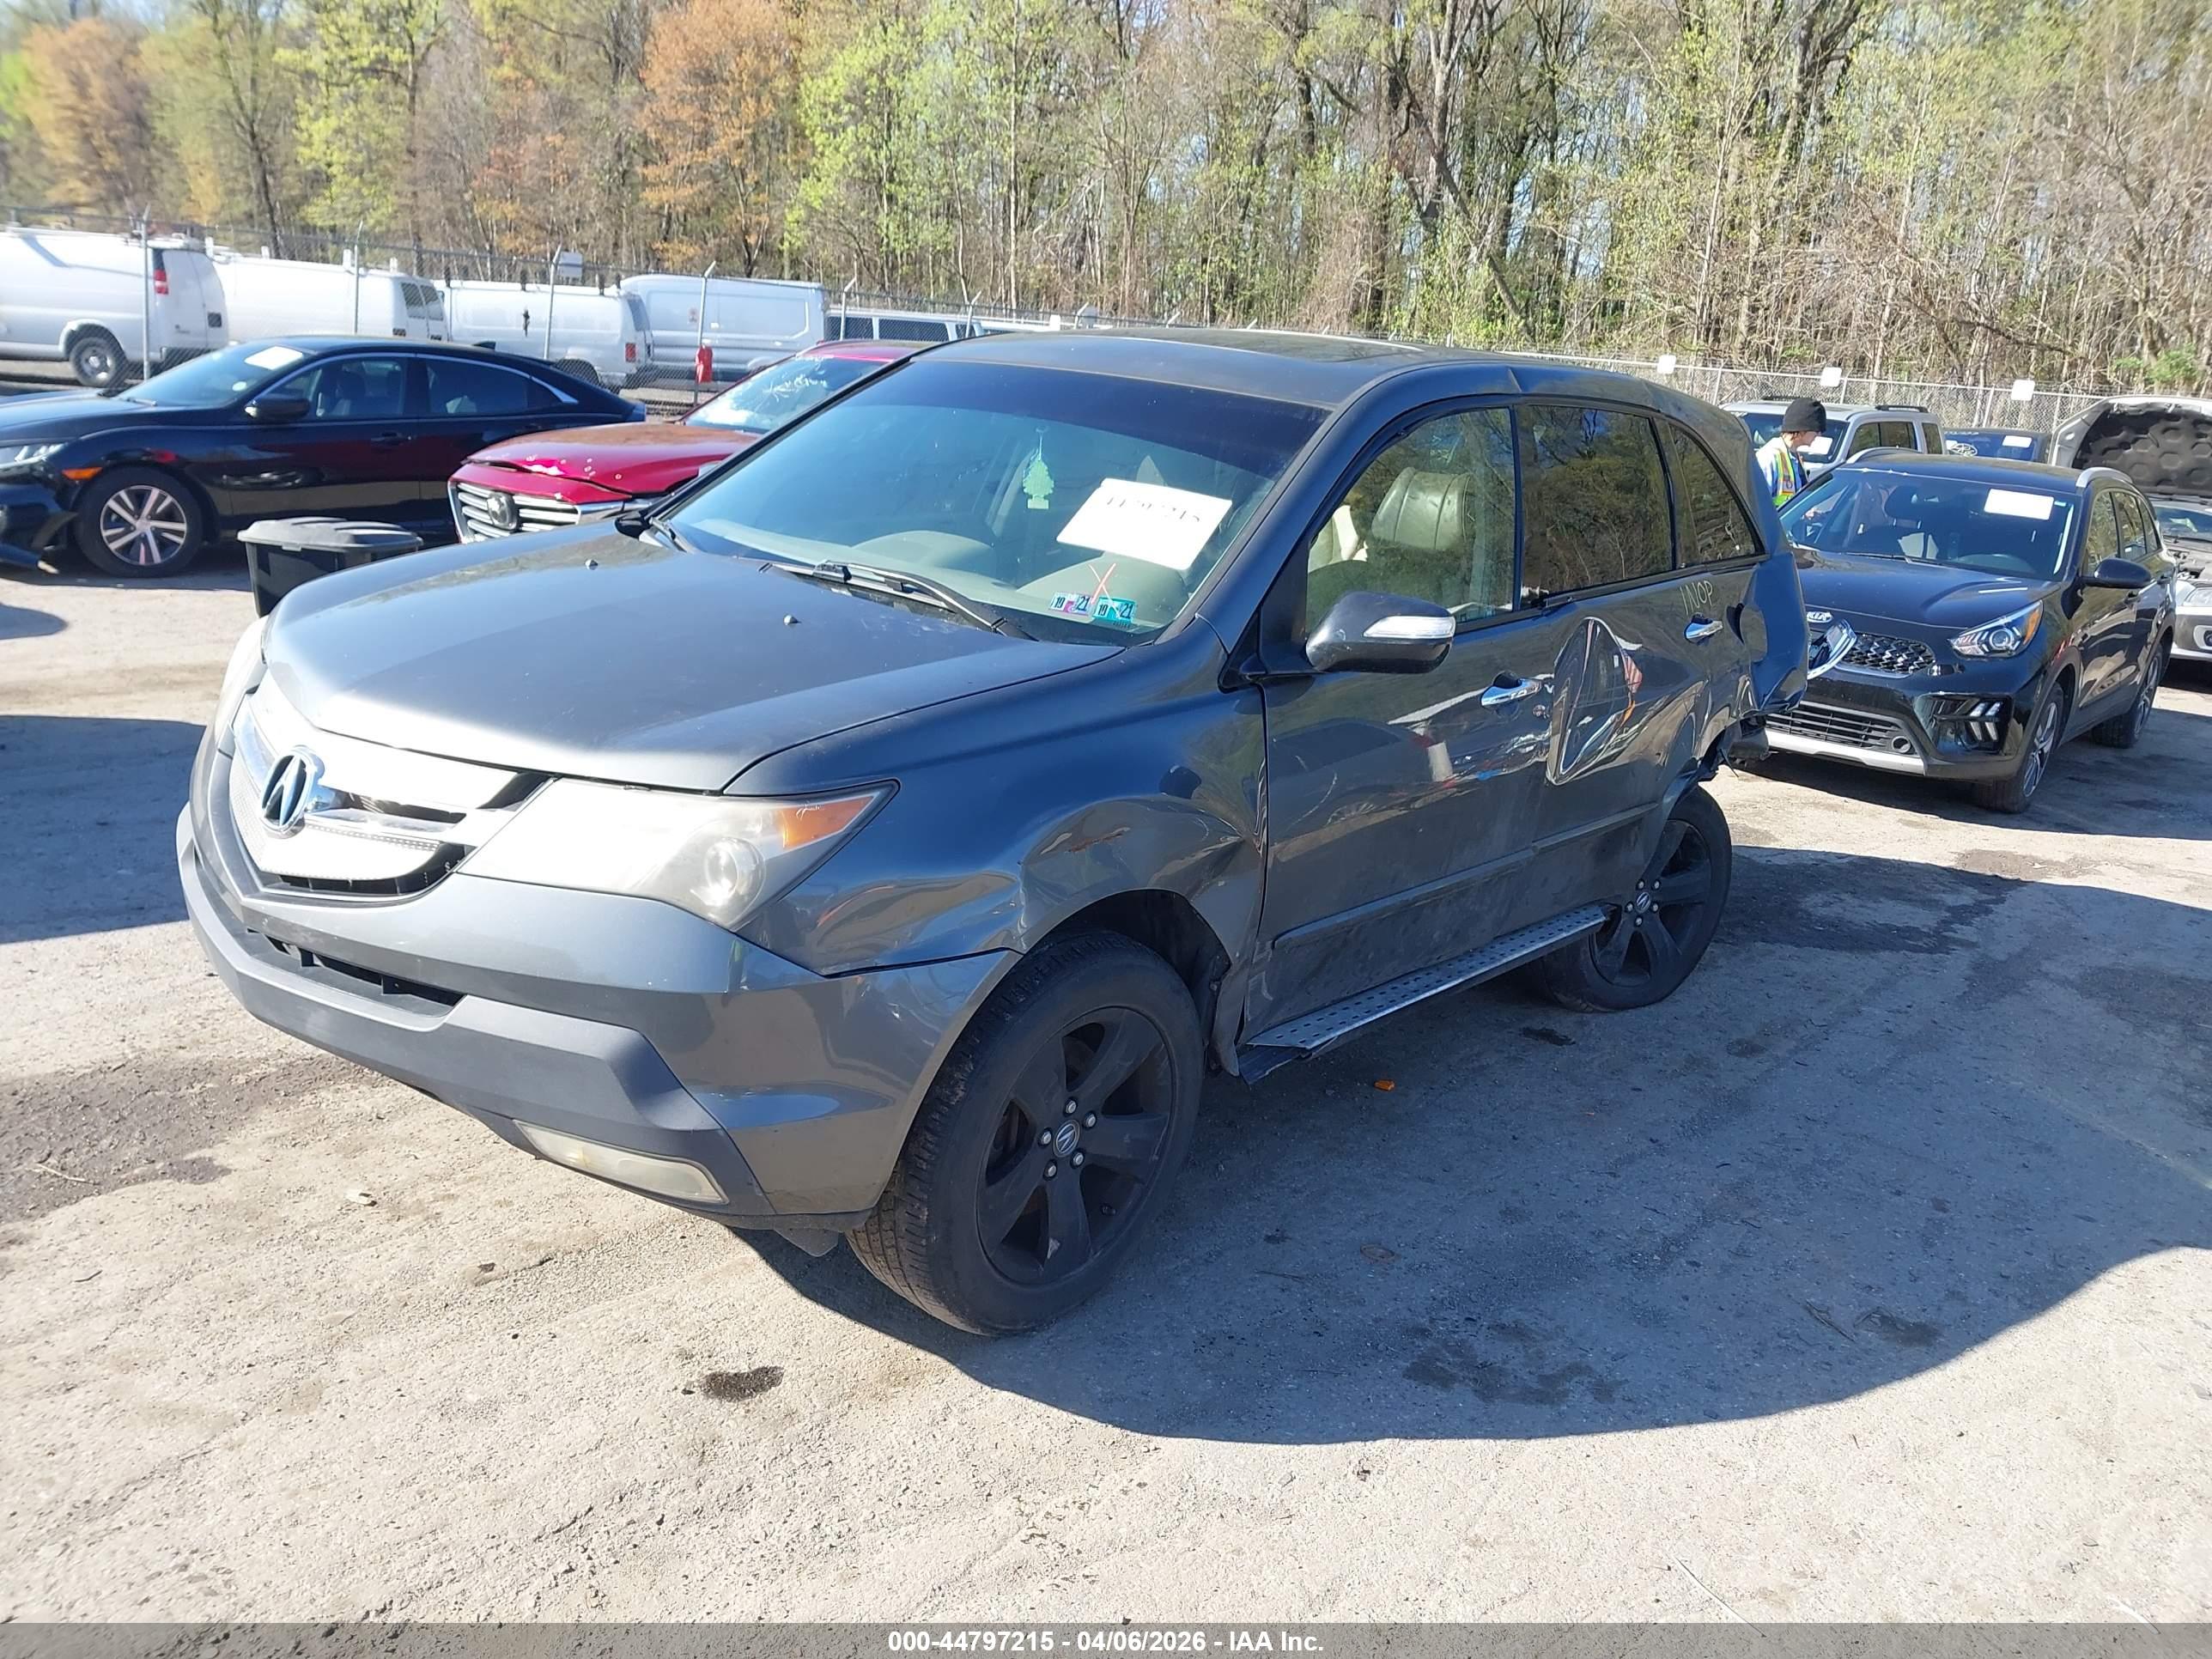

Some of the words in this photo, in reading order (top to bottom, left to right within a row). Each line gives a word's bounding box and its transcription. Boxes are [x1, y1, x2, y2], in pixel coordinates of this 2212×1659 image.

[1076, 596, 1091, 611] 21
[1679, 580, 1713, 616] INOP
[1120, 603, 1133, 618] 21
[1806, 611, 1831, 621] KIA
